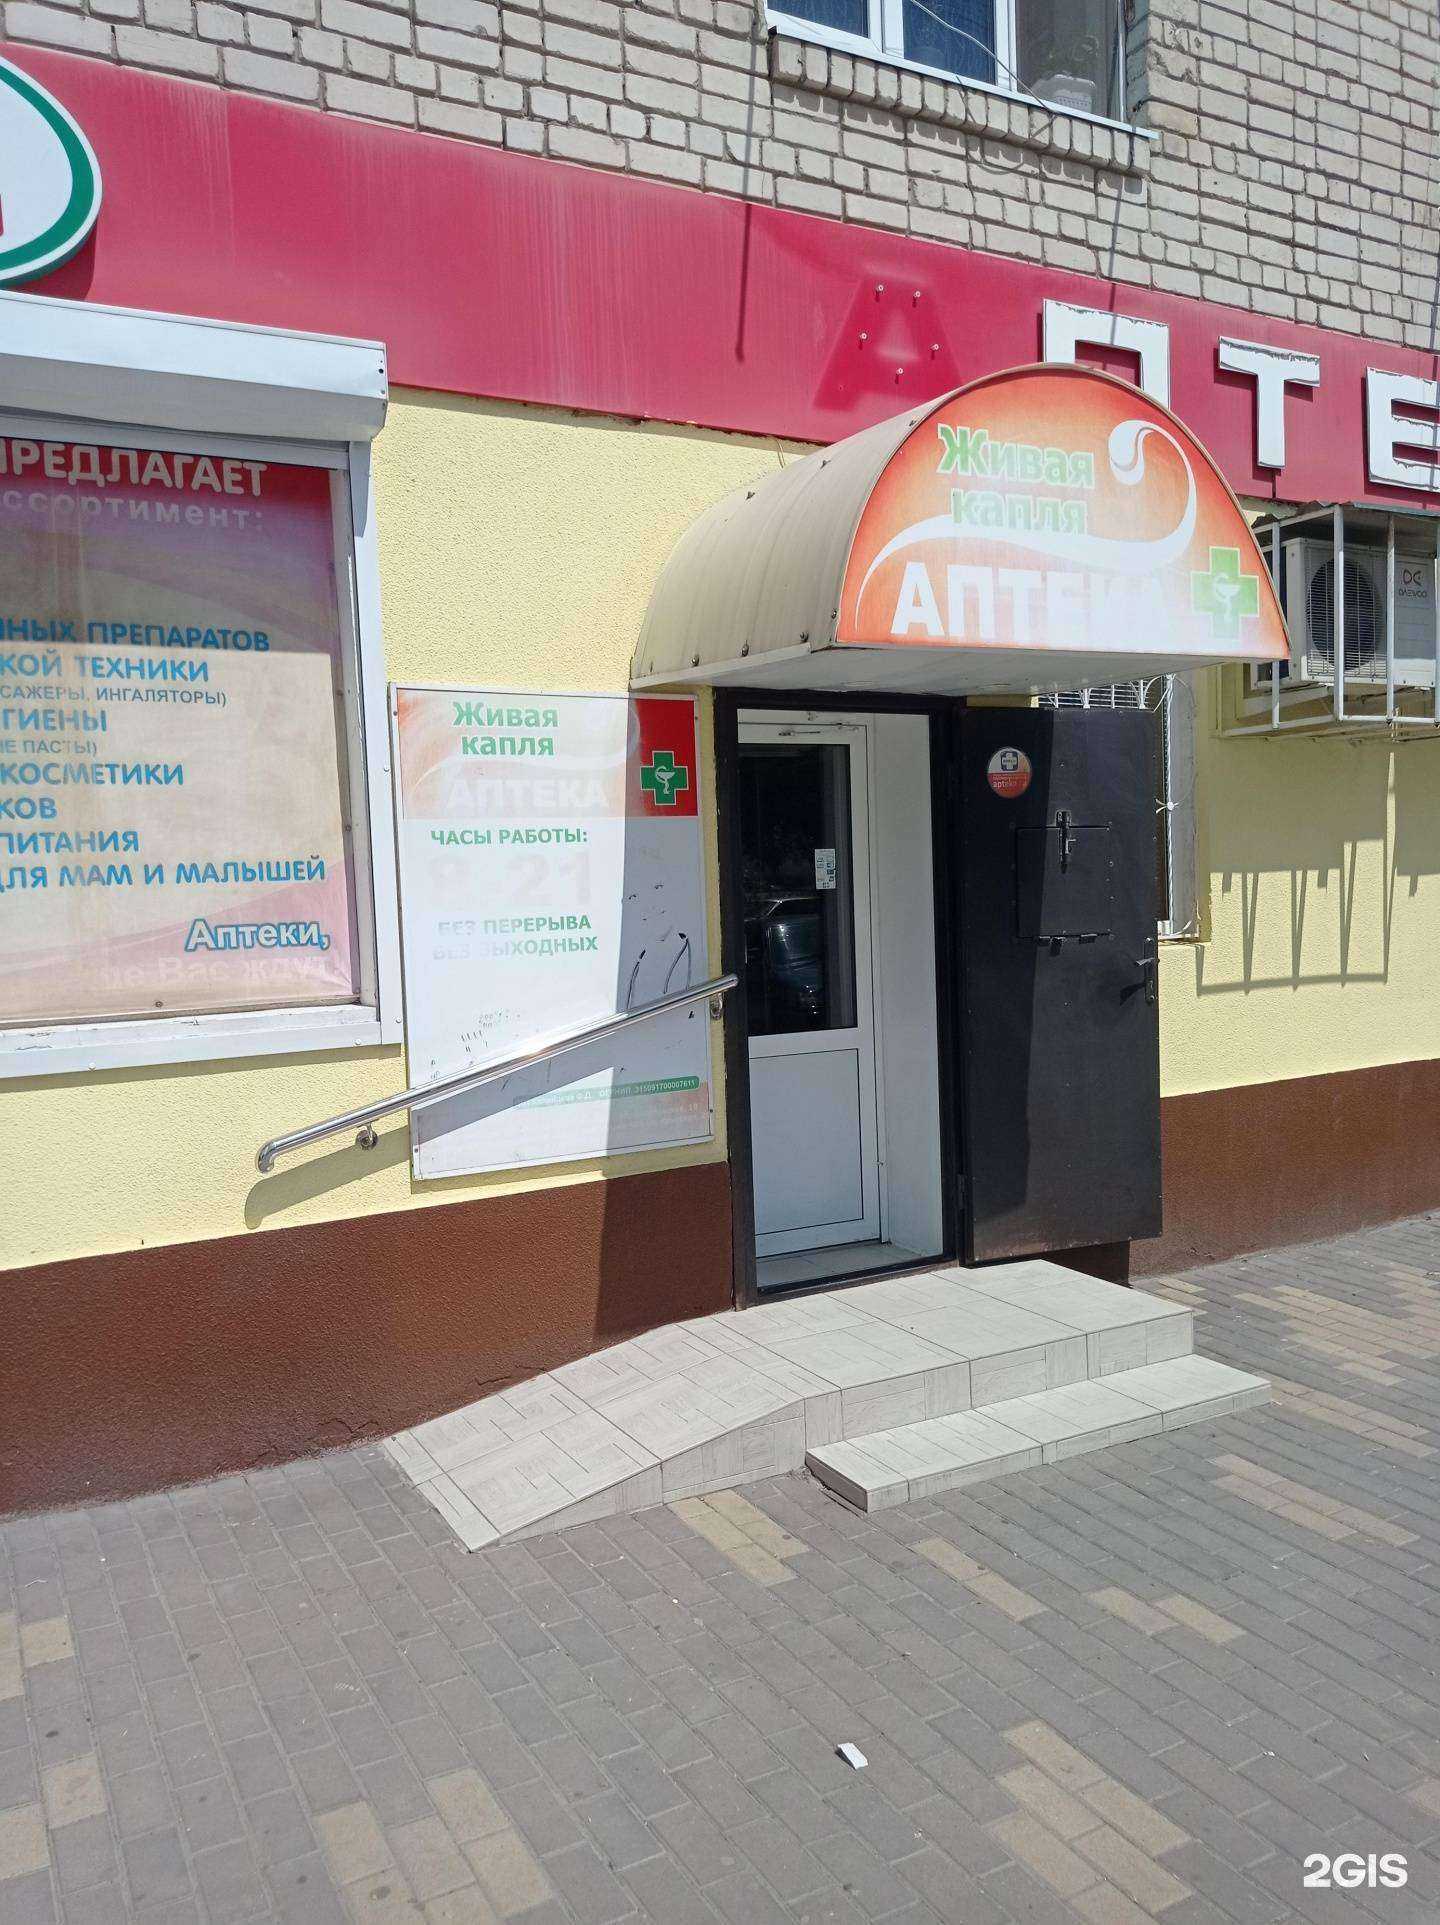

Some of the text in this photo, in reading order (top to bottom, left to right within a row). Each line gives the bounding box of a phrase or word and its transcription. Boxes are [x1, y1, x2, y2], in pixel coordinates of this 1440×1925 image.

[0, 437, 268, 497] РЕДЛАГАЕТ
[938, 423, 1094, 489] Живая
[951, 487, 1088, 536] капля
[0, 617, 270, 652] НЫХ ПРЕПАРАТОВ
[0, 648, 209, 682] КОЙ ТЕХНИКИ
[96, 687, 227, 706] ИНГАЛЯТОРЫ)
[3, 708, 107, 732] ГИЕНЫ
[452, 701, 559, 729] Живая
[23, 739, 98, 758] ПАСТЫ)
[461, 735, 556, 758] капля
[0, 763, 184, 786] КОСМЕТИКИ
[445, 778, 610, 808] АПТЕКА
[431, 827, 589, 846] ЧАСЫ РАБОТЫ:
[0, 855, 327, 893] ЛЯ МАМ И МАЛЫШЕЙ
[184, 918, 331, 952] Аптеки,
[484, 915, 592, 935] ПЕРЕРЫВА
